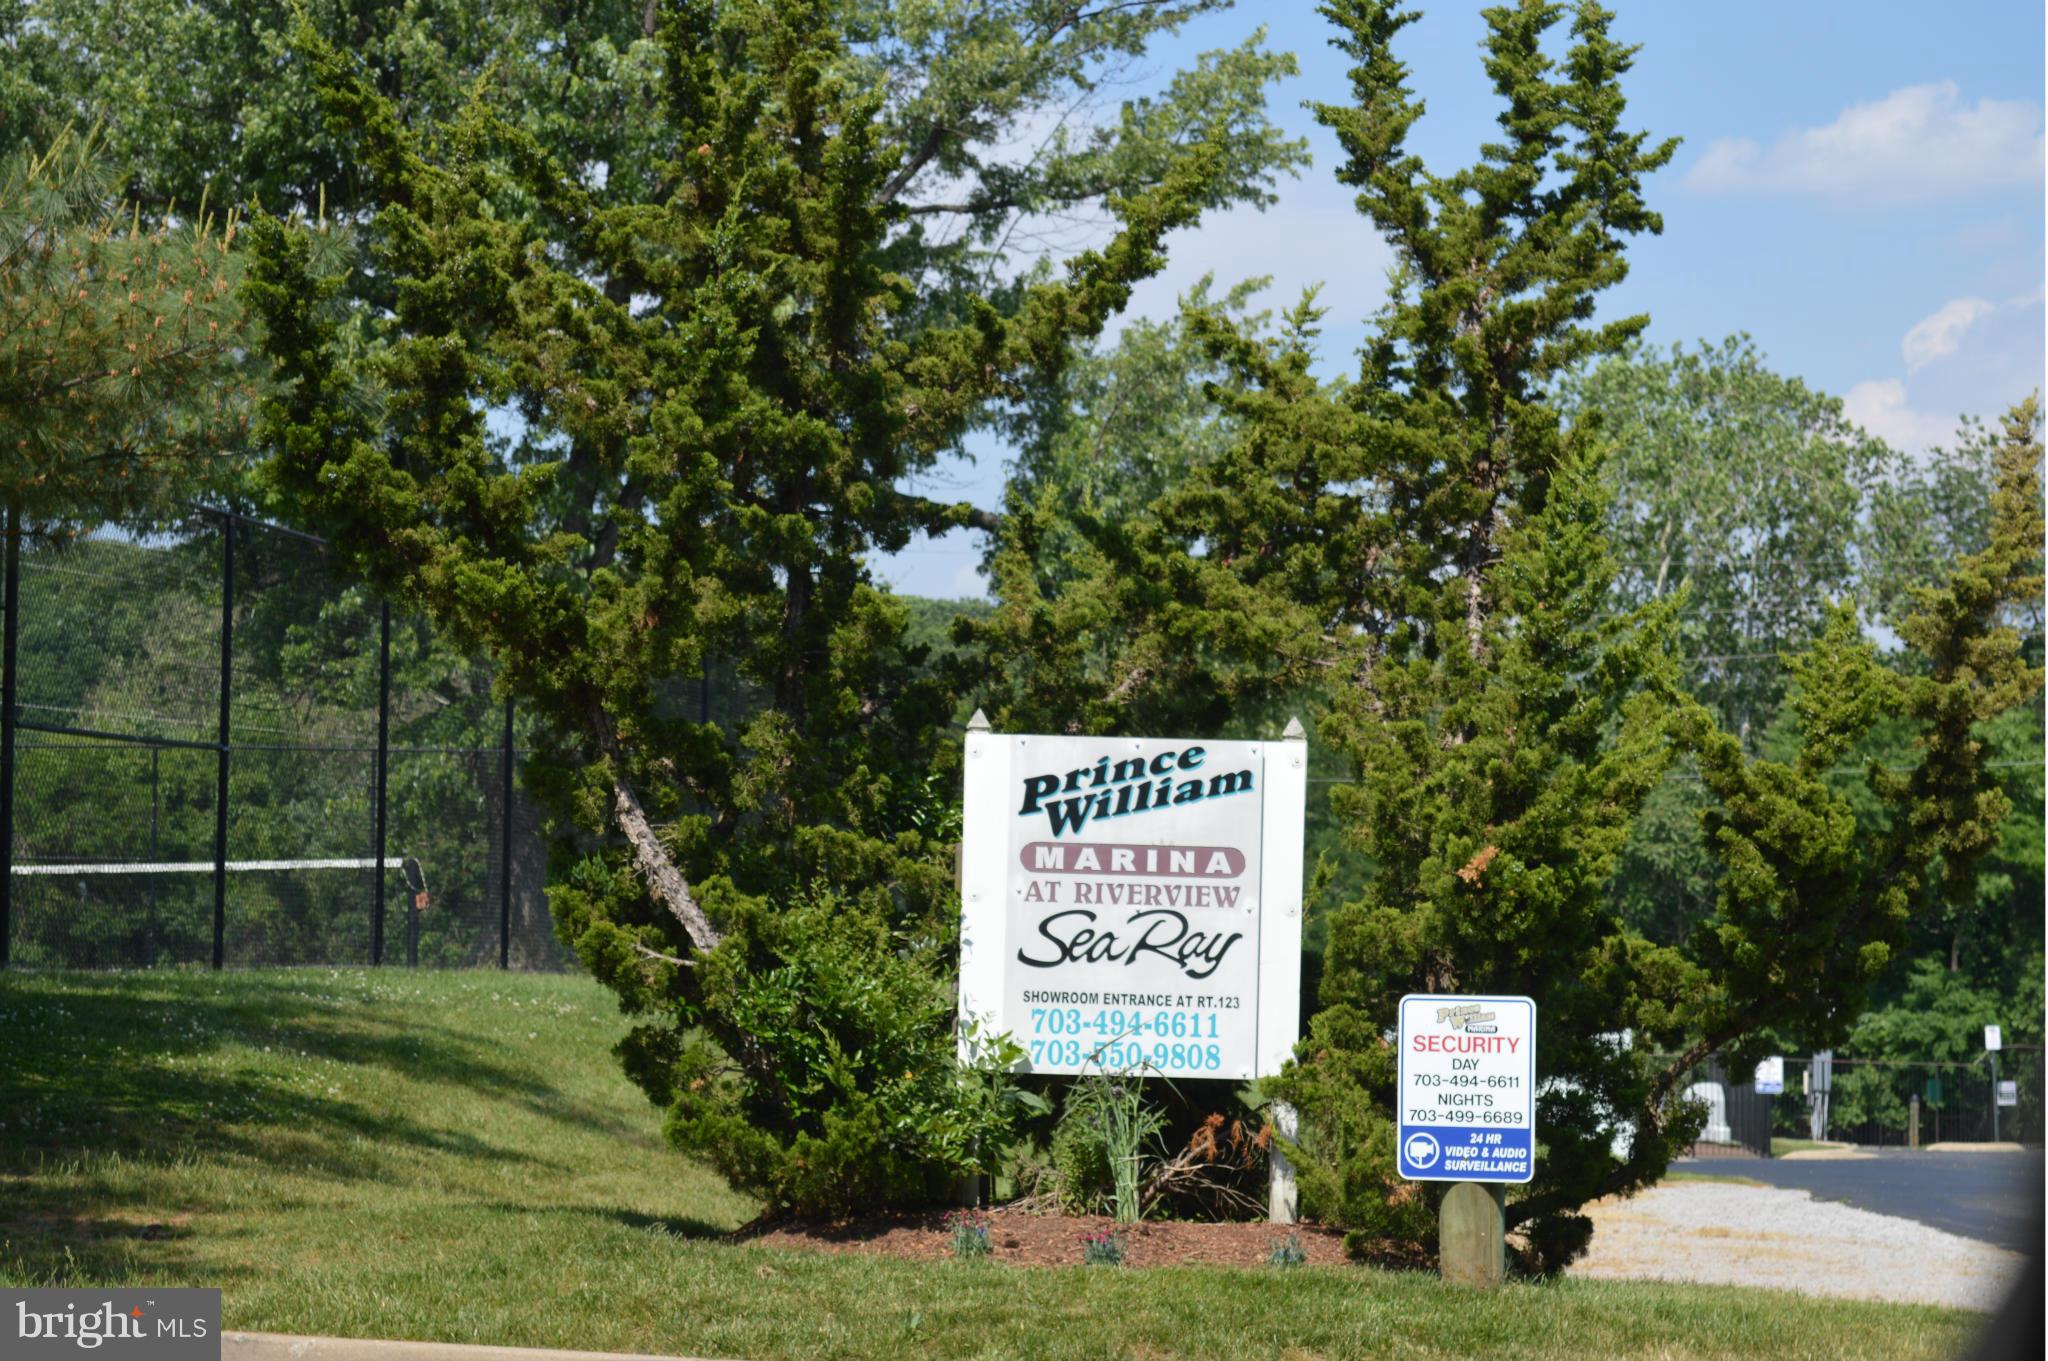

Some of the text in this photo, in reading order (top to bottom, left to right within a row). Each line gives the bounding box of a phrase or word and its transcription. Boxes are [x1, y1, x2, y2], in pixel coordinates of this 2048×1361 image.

[1018, 745, 1207, 816] Prince
[1045, 769, 1255, 838] William
[1034, 846, 1233, 875] MARINA
[1024, 880, 1241, 909] AT RIVERVIEW
[1017, 909, 1243, 980] Sea Ray
[1023, 990, 1241, 1009] SHOWROOM ENTRANCE AT RT.123
[1031, 1008, 1220, 1039] 703-494-6611
[1413, 1035, 1520, 1054] SECURITY
[1030, 1039, 1221, 1071] 703-550-9808
[1452, 1058, 1480, 1071] DAY
[1413, 1074, 1520, 1089] 703-494-6611
[1438, 1093, 1494, 1107] NIGHTS
[1409, 1109, 1523, 1124] 703-499-6689
[1470, 1133, 1502, 1145] 24 HR
[1445, 1146, 1527, 1159] VIDEO & AUDIO
[1444, 1160, 1527, 1173] SURVEILLANCE
